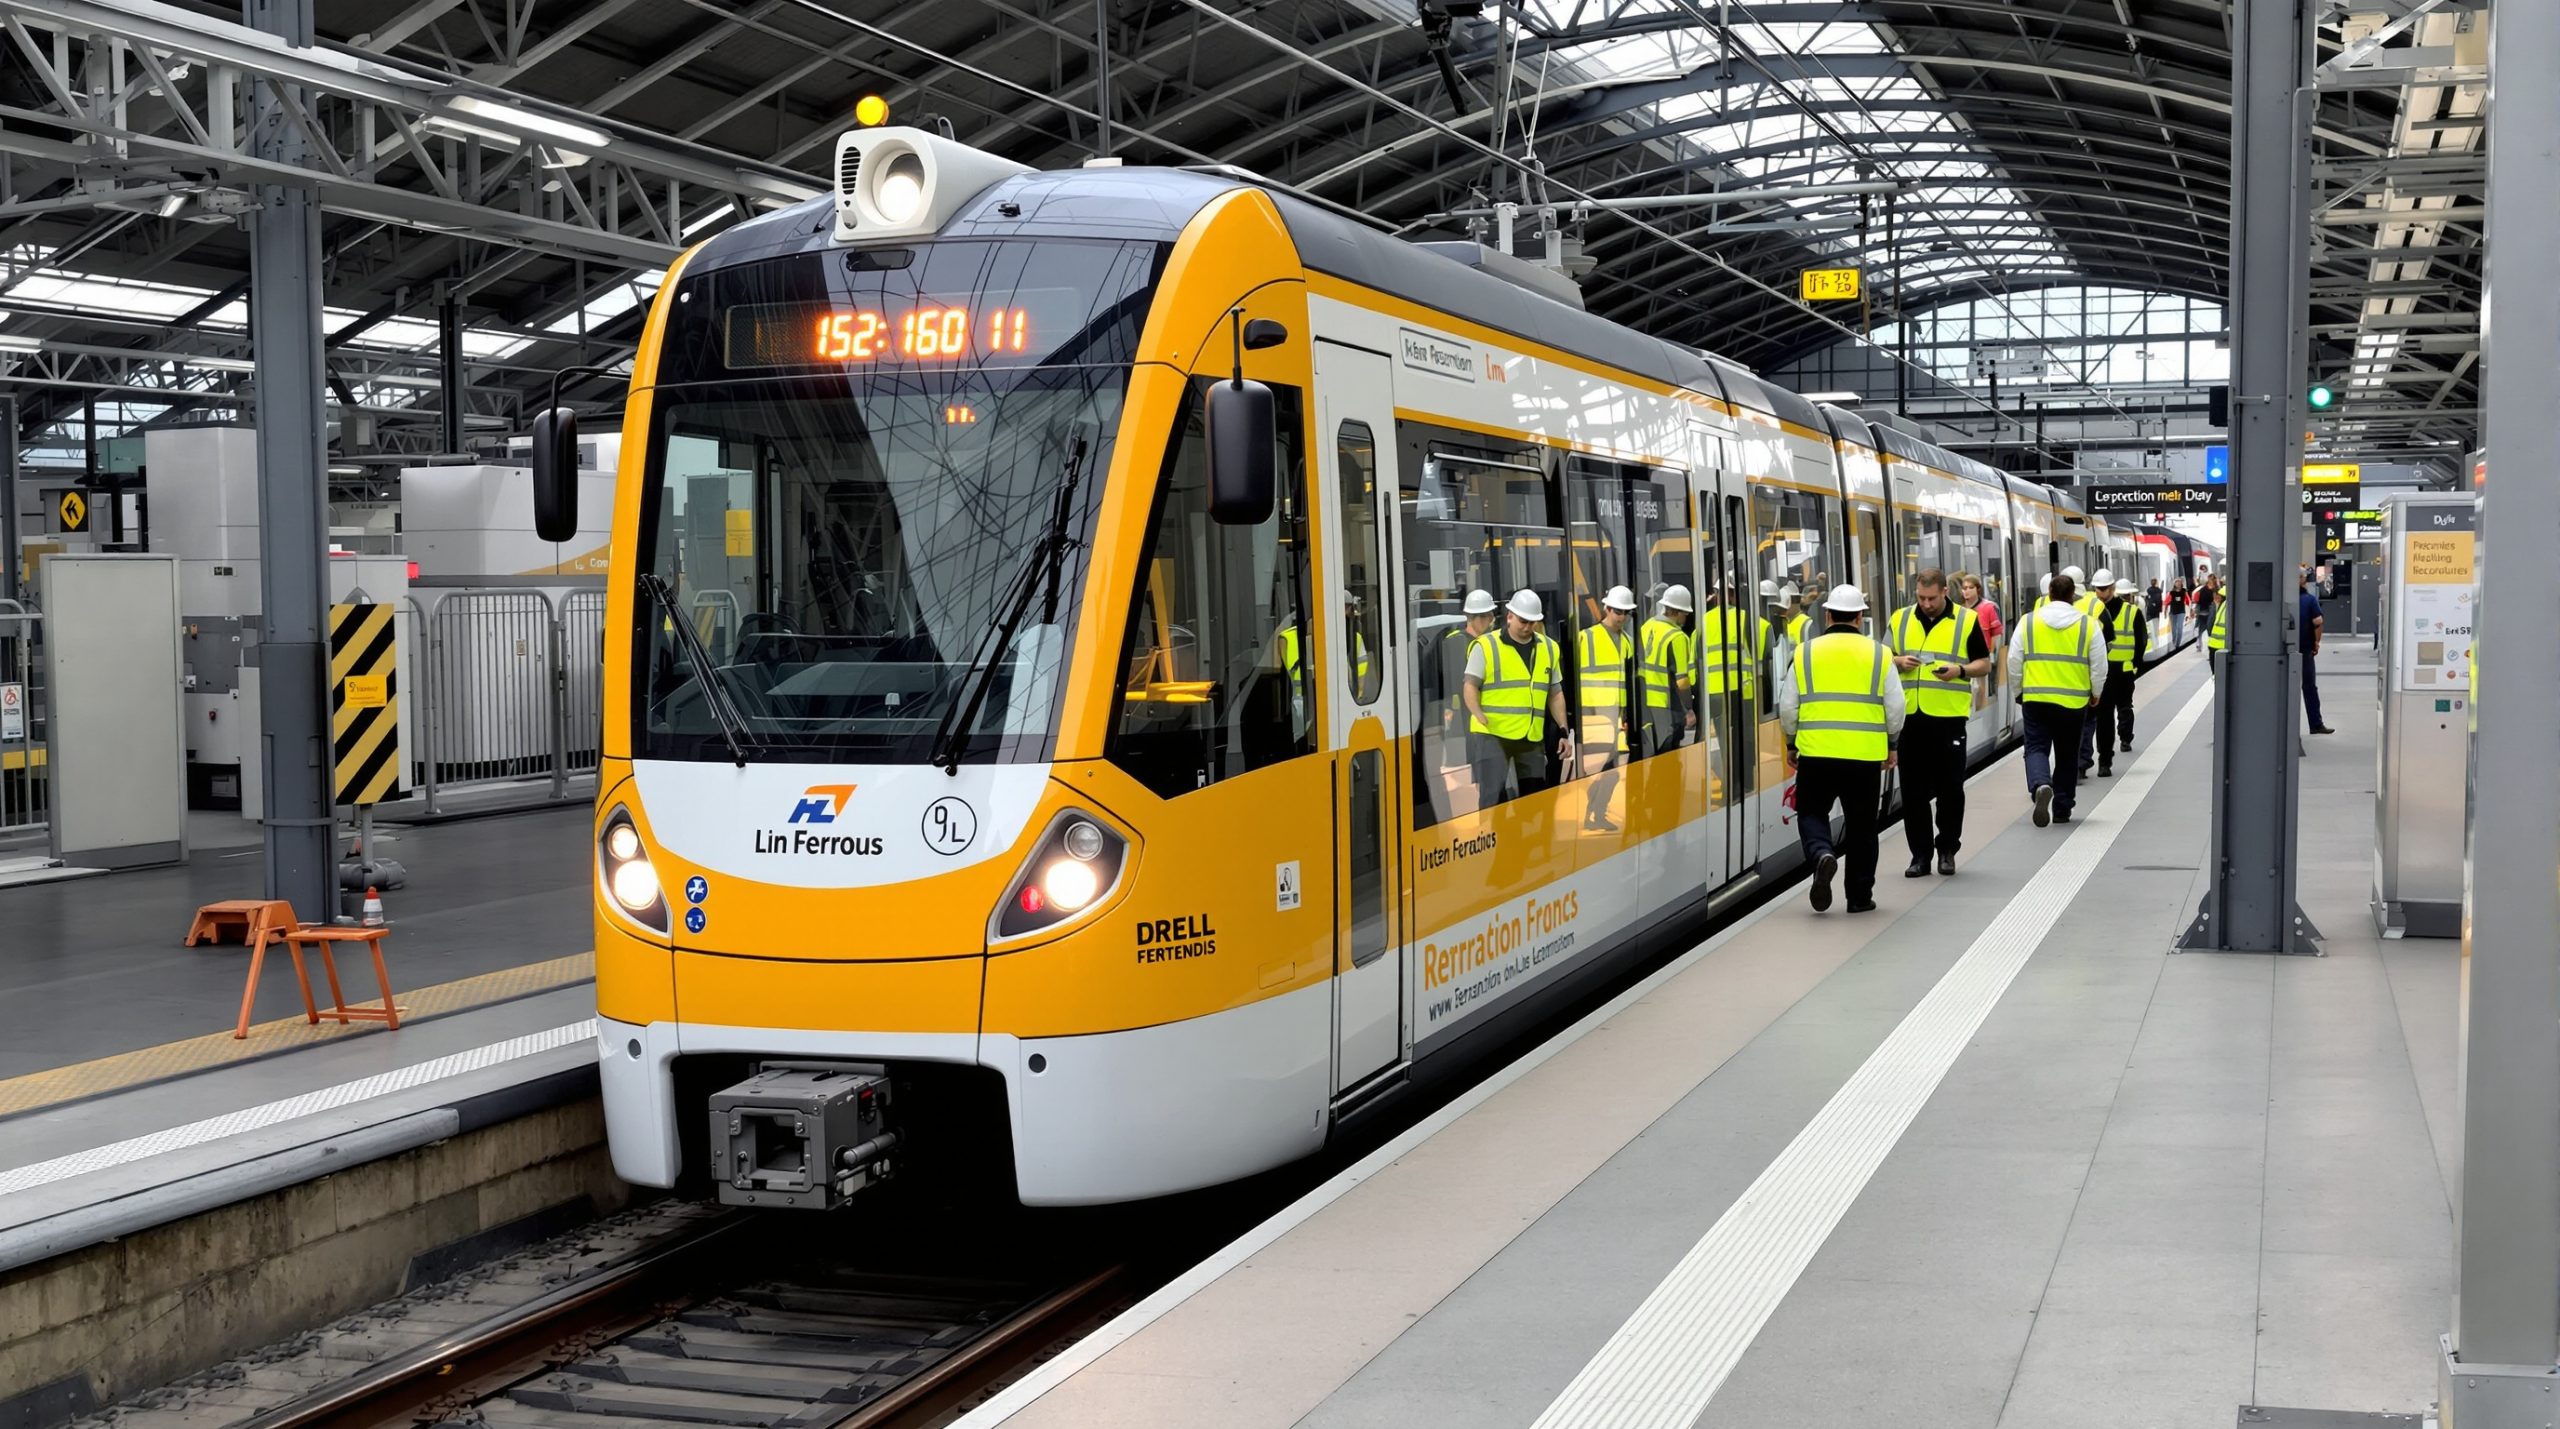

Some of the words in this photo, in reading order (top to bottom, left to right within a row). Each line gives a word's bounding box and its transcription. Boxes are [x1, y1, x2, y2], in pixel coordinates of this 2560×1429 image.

[904, 309, 967, 356] 160
[991, 309, 1025, 350] 11
[754, 829, 788, 854] Lin
[794, 830, 883, 856] Ferrous
[1136, 913, 1216, 945] DRELL
[1137, 940, 1216, 964] FERTENDIS
